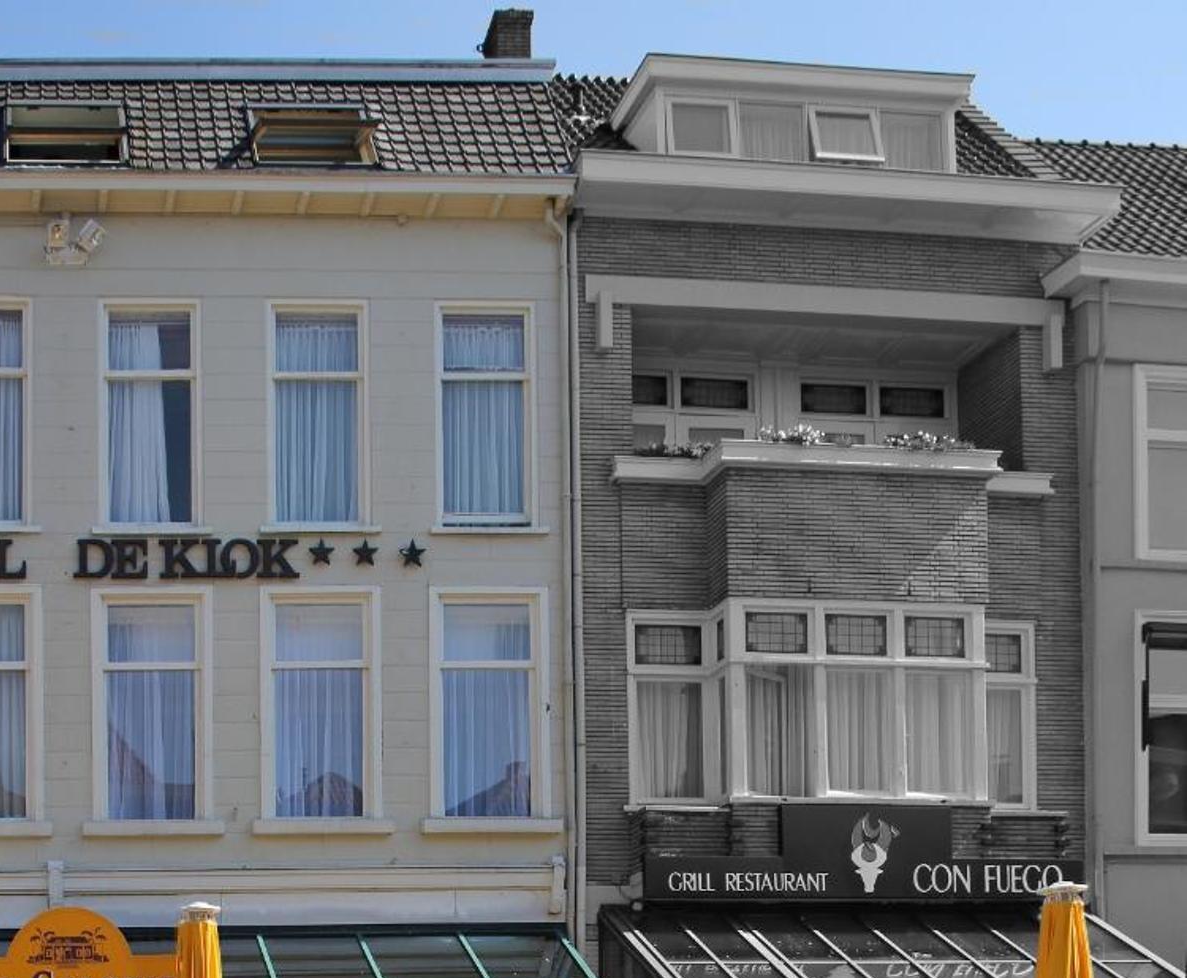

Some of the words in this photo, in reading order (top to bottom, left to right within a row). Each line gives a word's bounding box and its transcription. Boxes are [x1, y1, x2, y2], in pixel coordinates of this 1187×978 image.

[73, 538, 149, 579] DE
[159, 538, 301, 579] KLOK
[668, 872, 716, 891] GRILL
[725, 872, 829, 892] RESTAURANT
[913, 863, 971, 893] CON
[984, 864, 1063, 893] FUEGO
